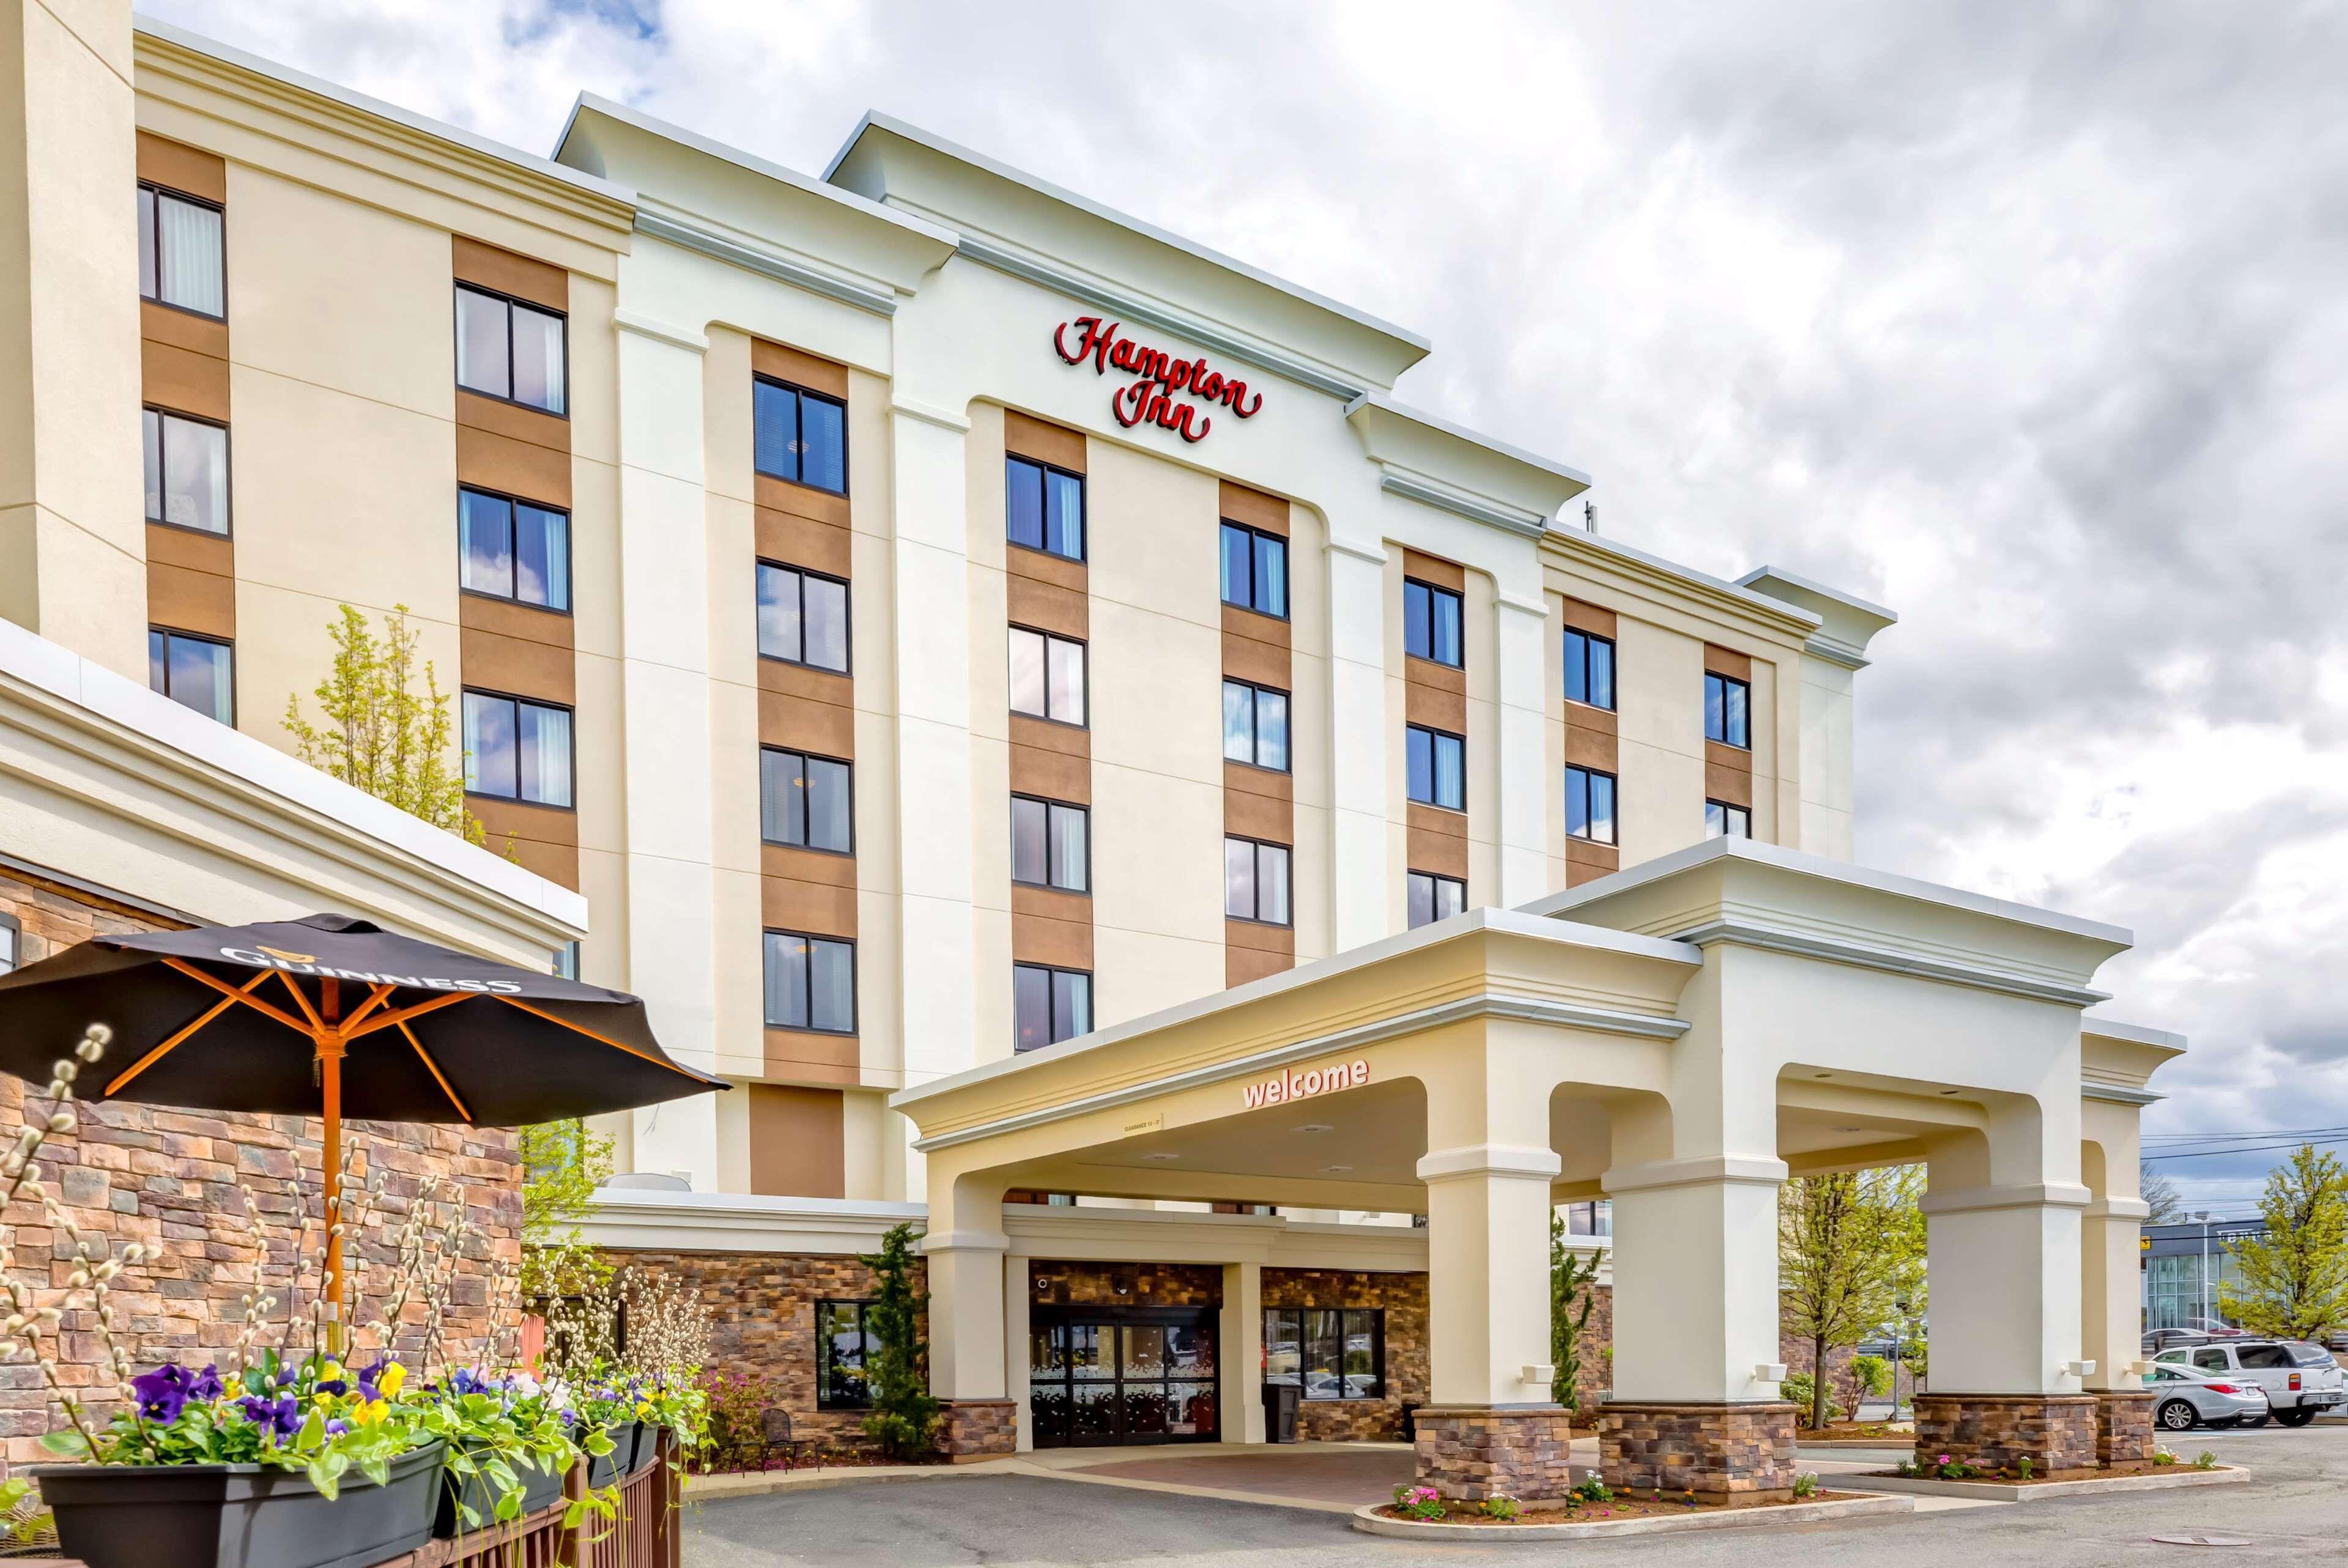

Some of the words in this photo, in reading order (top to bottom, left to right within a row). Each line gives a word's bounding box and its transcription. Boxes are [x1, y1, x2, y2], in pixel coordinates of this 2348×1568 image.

[1054, 317, 1262, 419] Hampton
[1112, 380, 1211, 443] Inn
[220, 947, 523, 994] GUINNESS
[1243, 1060, 1369, 1108] welcome
[1124, 1122, 1146, 1131] CLEARANCE
